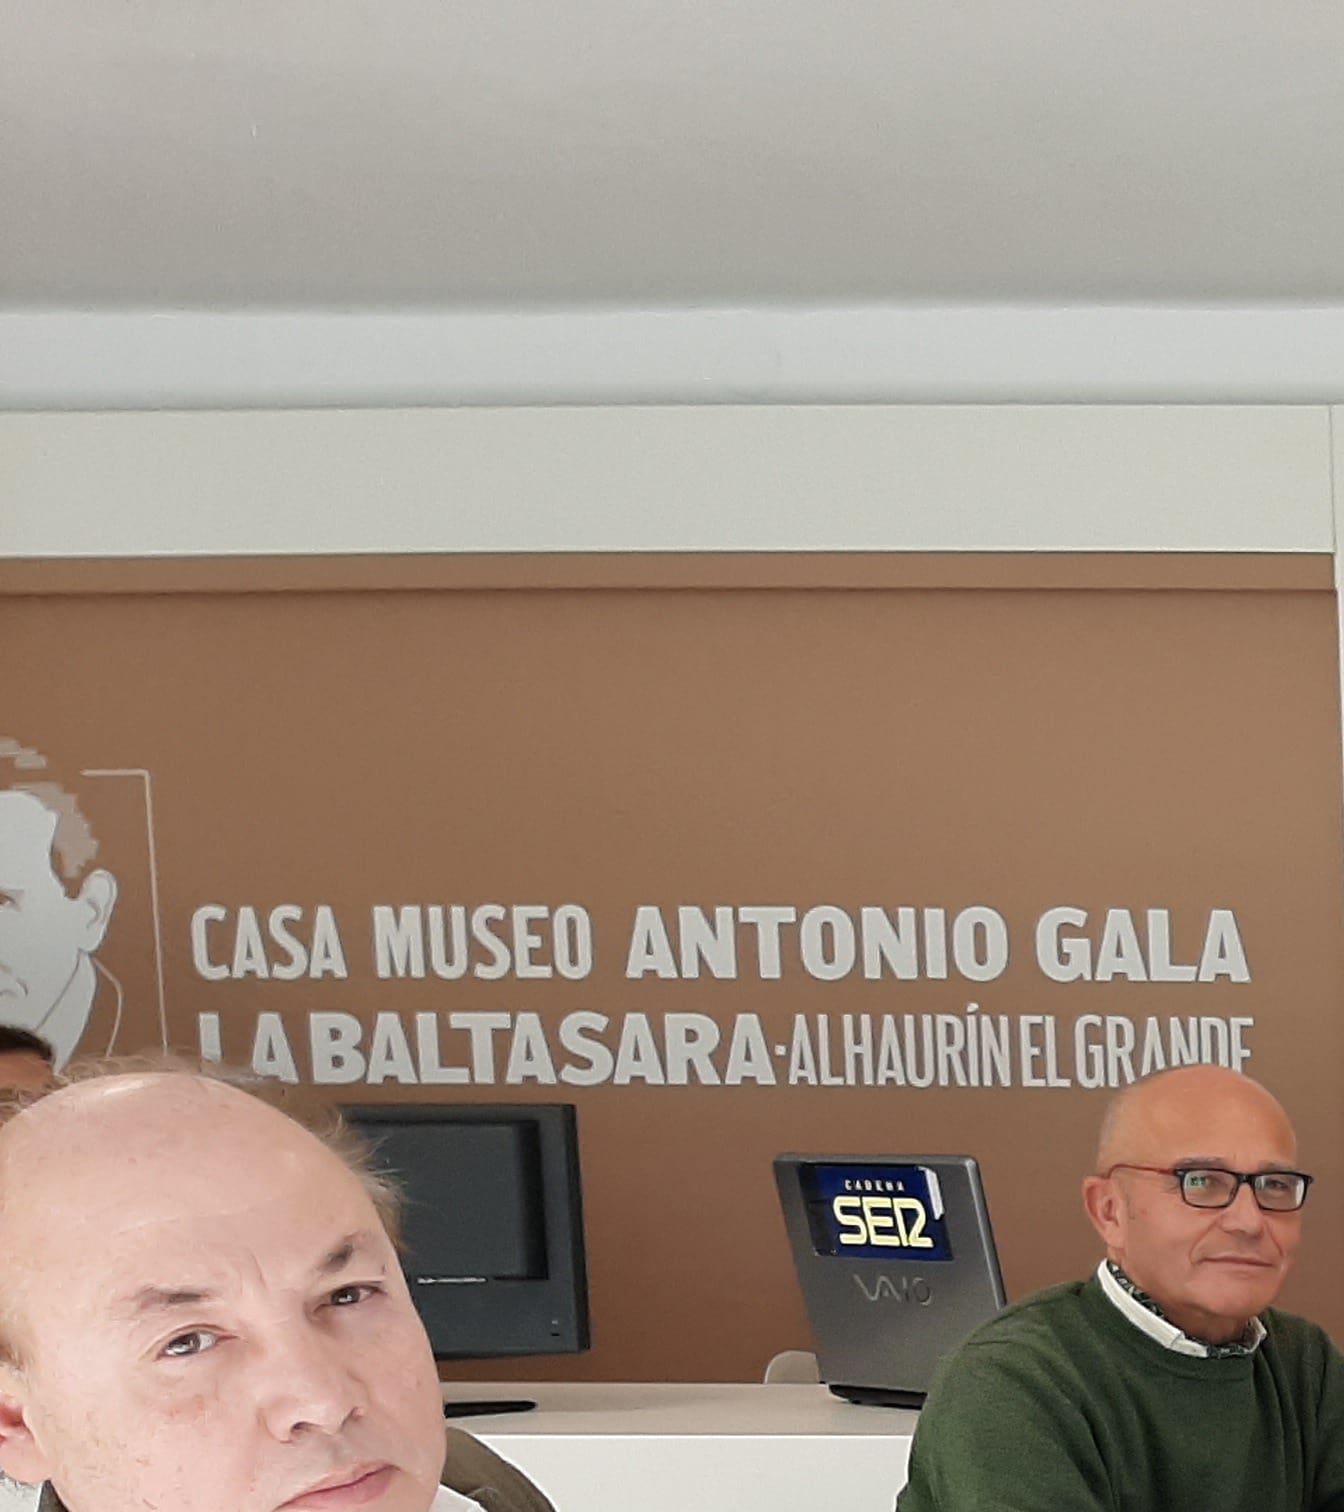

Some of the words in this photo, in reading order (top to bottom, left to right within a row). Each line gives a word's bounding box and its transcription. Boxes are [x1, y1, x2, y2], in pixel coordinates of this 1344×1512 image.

[191, 904, 347, 980] CASA
[373, 904, 592, 980] MUSEO
[626, 904, 1008, 982] ANTONIO
[1036, 906, 1251, 983] GALA
[199, 1012, 299, 1084] LA
[1020, 1015, 1071, 1088] EL
[1075, 1015, 1254, 1089] GRANDE
[845, 1180, 904, 1191] CADENA
[833, 1196, 933, 1248] SER
[853, 1273, 932, 1306] VAIO
